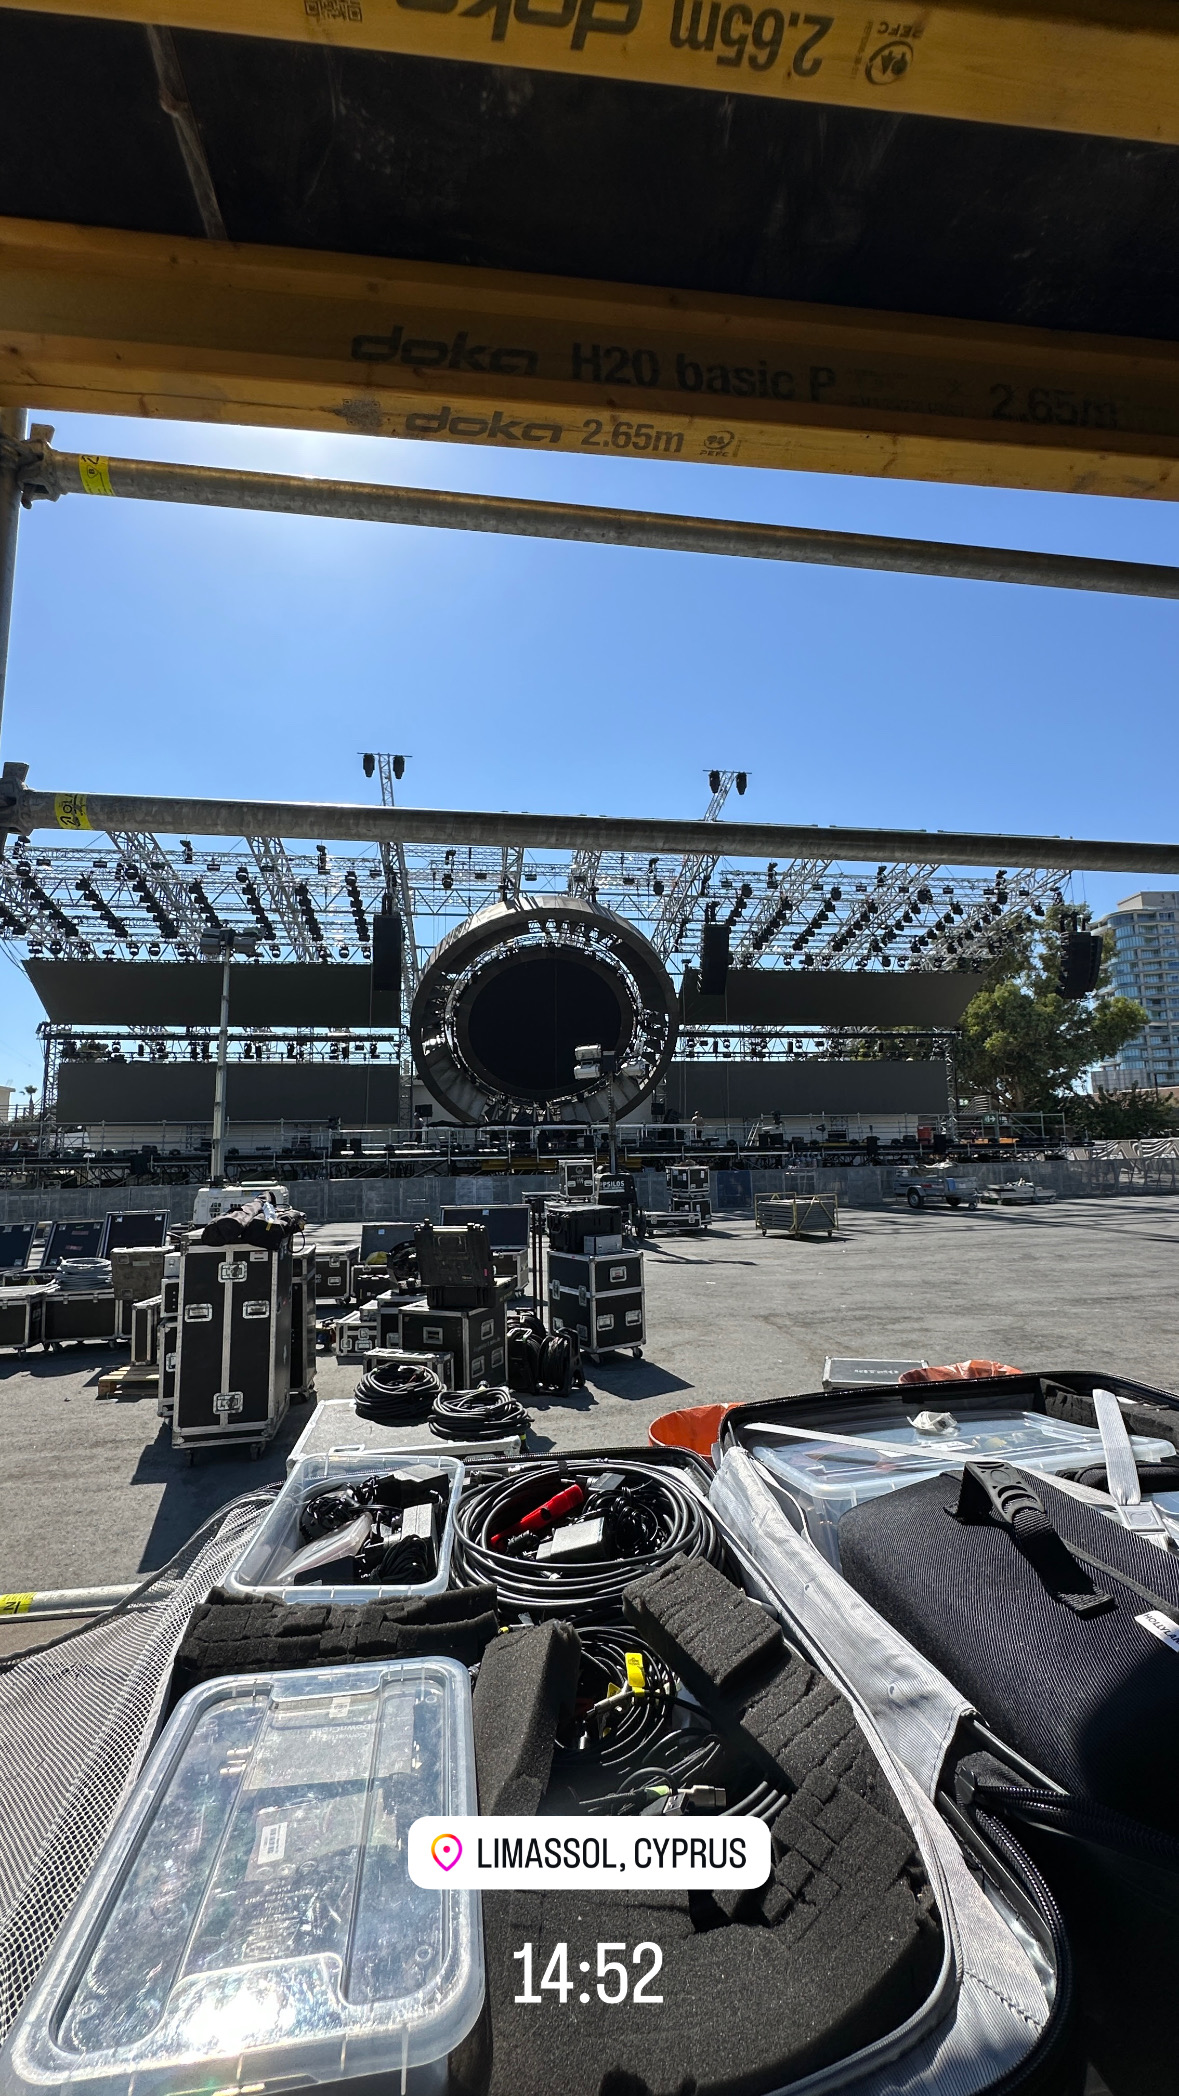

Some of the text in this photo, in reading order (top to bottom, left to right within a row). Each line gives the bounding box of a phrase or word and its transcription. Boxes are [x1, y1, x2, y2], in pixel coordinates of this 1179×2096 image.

[669, 0, 834, 78] 2.65m
[351, 324, 539, 375] doka
[571, 341, 661, 388] H20
[676, 352, 795, 400] basic
[809, 365, 836, 401] P
[989, 383, 1118, 429] 2.65m
[405, 406, 685, 453] doka 2.65m
[699, 450, 730, 458] PEFC
